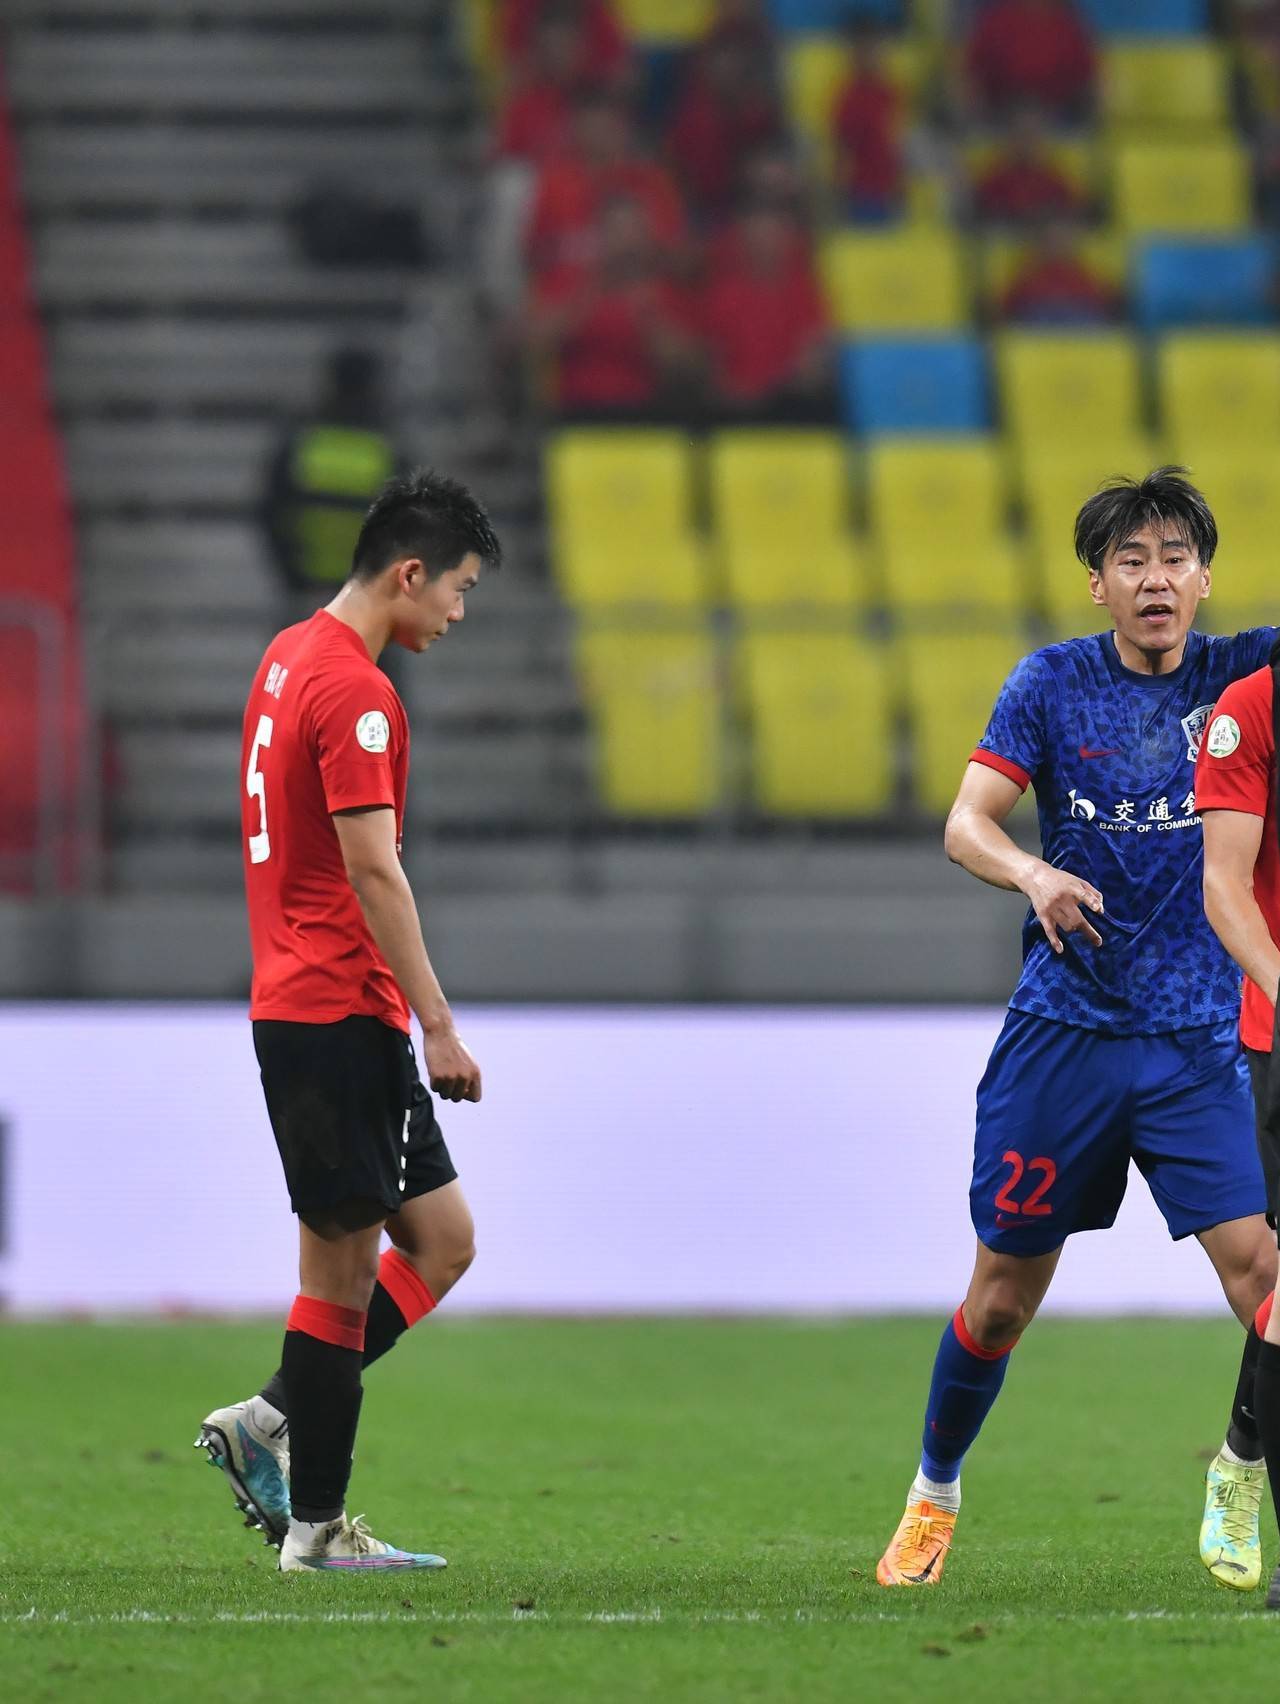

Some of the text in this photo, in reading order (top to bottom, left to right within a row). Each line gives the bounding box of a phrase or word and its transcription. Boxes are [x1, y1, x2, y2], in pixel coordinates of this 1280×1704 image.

[246, 714, 273, 864] 5
[1099, 822, 1131, 832] BANK
[1136, 824, 1153, 833] OF
[995, 1150, 1057, 1216] 22
